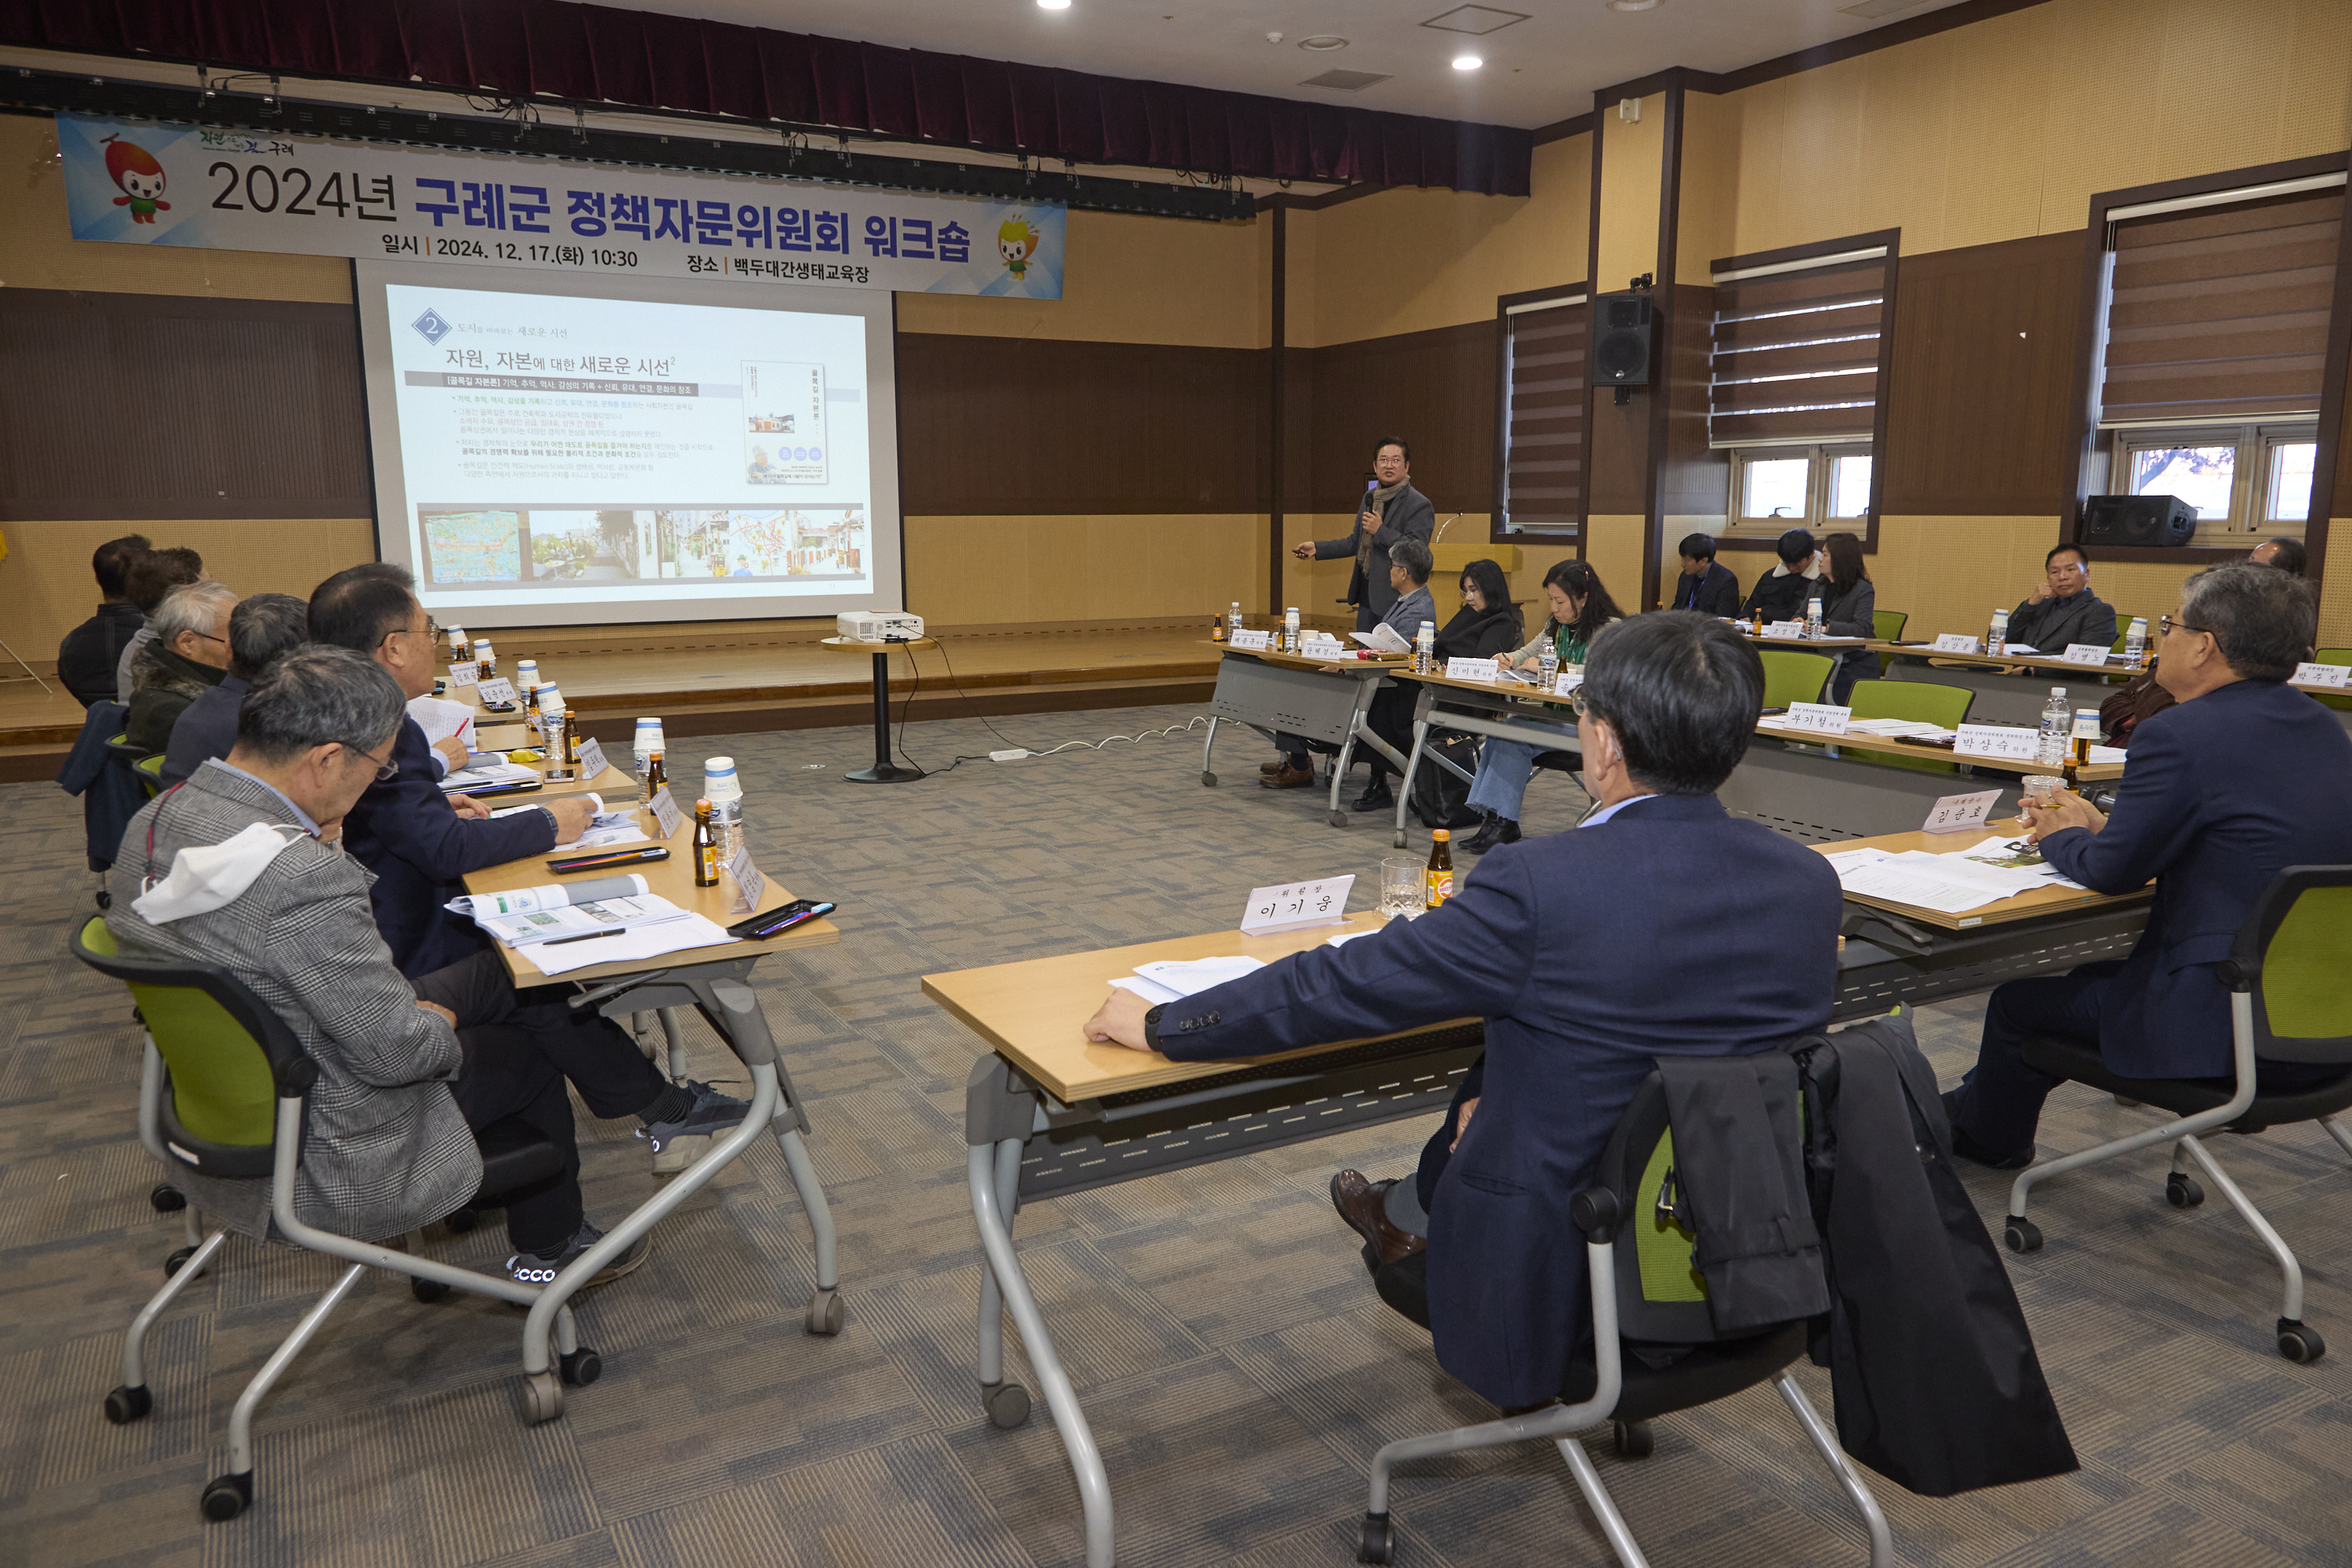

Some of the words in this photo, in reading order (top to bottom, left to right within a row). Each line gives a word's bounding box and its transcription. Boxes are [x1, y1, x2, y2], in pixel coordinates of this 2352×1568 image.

[268, 141, 294, 156] 구례
[207, 160, 398, 223] 2024년
[415, 177, 551, 234] 구례군
[566, 188, 850, 256] 정책자문위원회
[863, 214, 971, 264] 워크숍
[381, 233, 419, 256] 일시
[437, 238, 488, 260] 2024.
[495, 242, 523, 261] 12.
[528, 245, 583, 266] 17.(화)
[591, 249, 638, 268] 10:30
[687, 253, 719, 273] 장소
[734, 257, 870, 284] 백두대간생태교육장
[425, 317, 439, 334] 2
[517, 326, 546, 338] 새로운
[550, 328, 568, 339] 시선
[446, 348, 488, 371] 자원,
[496, 351, 545, 371] 자본에
[550, 358, 575, 372] 대한
[579, 355, 631, 375] 새로운
[448, 376, 473, 386] [골목길
[474, 377, 500, 387] 자본론]
[503, 379, 518, 388] 기억,
[521, 379, 537, 389] 추억,
[540, 380, 556, 390] 역사,
[558, 380, 579, 390] 감성의
[582, 382, 595, 391] 기록
[604, 383, 619, 392] 신뢰,
[622, 383, 637, 393] 유대,
[639, 385, 654, 394] 연결,
[656, 385, 676, 394] 문화의
[678, 386, 691, 394] 창조
[491, 396, 505, 405] 역사,
[1451, 666, 1479, 677] 신미현
[2299, 673, 2338, 683] 박주진
[1791, 714, 1827, 728] 부기철
[1963, 738, 2009, 752] 박상숙
[1938, 806, 1982, 823] 김순호
[1282, 885, 1322, 898] 위원장
[1261, 895, 1332, 919] 이기웅
